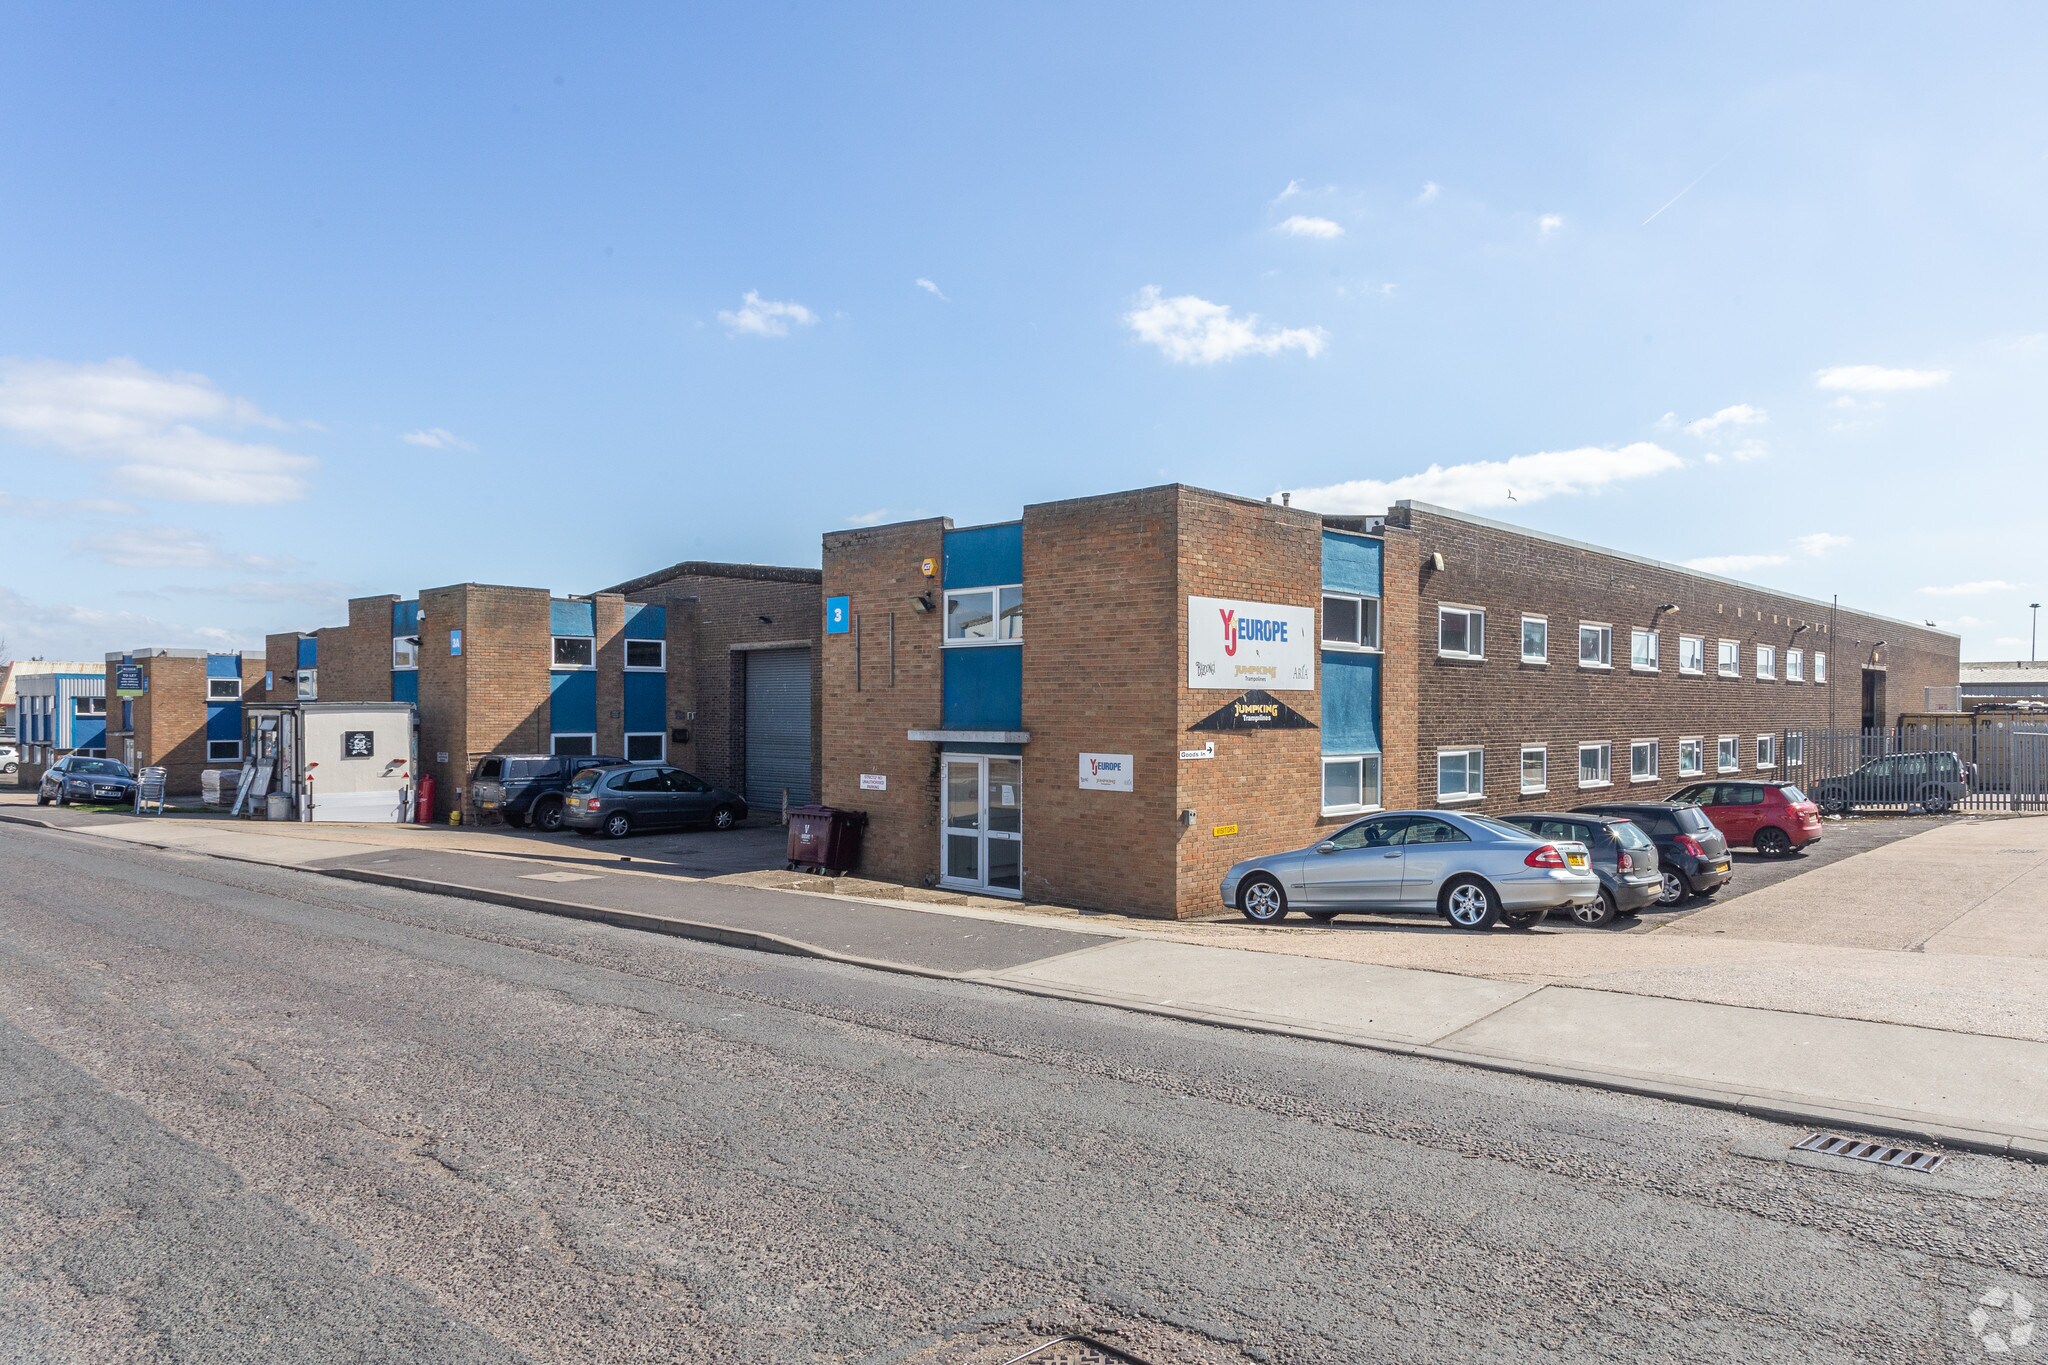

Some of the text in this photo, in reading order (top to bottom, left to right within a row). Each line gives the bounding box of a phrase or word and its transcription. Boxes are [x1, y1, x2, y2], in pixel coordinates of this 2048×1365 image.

[834, 607, 842, 622] 3
[1238, 618, 1288, 642] EUROPE
[452, 637, 460, 648] 3A
[1234, 664, 1278, 678] JUMPKING
[1234, 704, 1278, 716] JUMPKING
[1242, 714, 1271, 722] Trampolines
[1097, 762, 1121, 771] EUROPE
[1216, 825, 1235, 834] VISITORS
